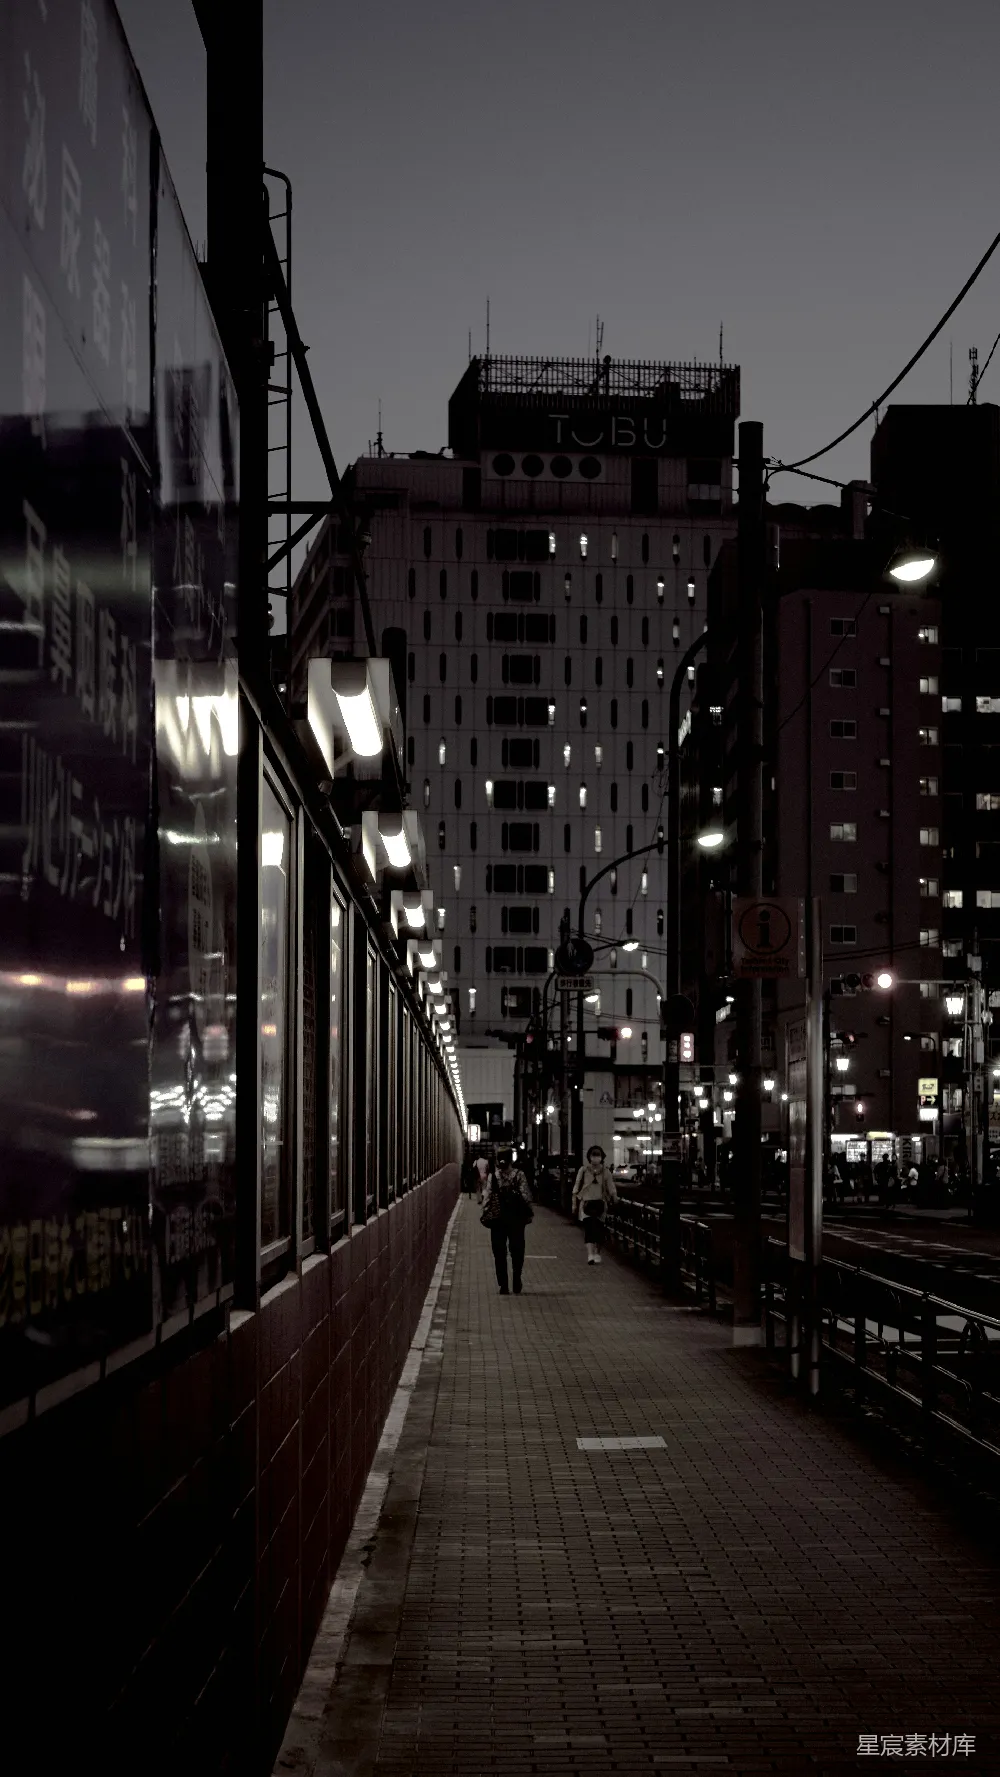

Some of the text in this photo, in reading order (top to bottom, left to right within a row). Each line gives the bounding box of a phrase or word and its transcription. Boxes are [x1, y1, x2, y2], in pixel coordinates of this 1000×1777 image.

[547, 414, 668, 449] TOBU
[21, 732, 137, 940] リハビリテーション科
